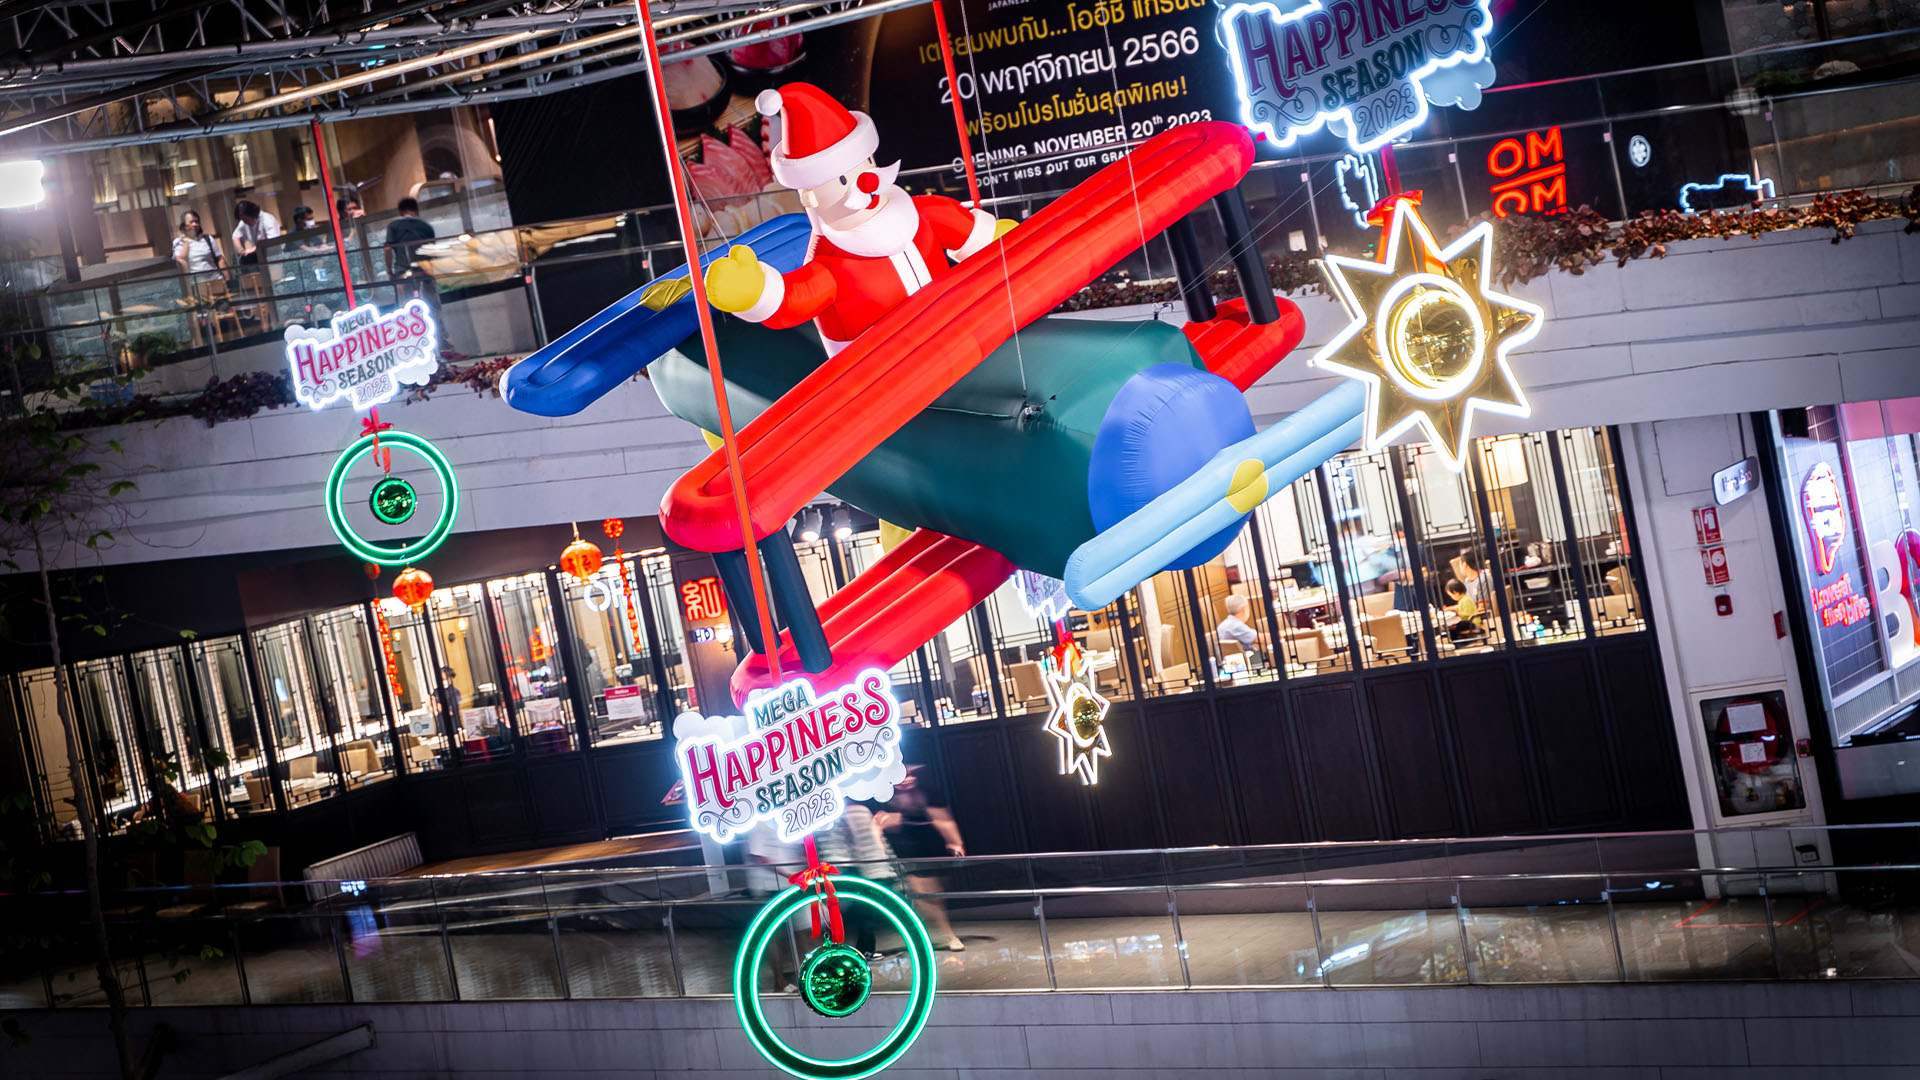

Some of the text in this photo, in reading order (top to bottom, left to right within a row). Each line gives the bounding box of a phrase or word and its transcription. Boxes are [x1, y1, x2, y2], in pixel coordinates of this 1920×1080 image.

[988, 0, 1029, 11] JAPANE
[980, 46, 1117, 96] พฤศจิกายน
[1123, 26, 1199, 67] 2566
[1235, 0, 1478, 99] HAPPINE
[1321, 28, 1427, 110] SEASON
[1355, 81, 1418, 144] 2023
[952, 144, 1029, 173] OENING
[1034, 125, 1127, 157] NOVEMBER
[1014, 166, 1042, 180] MISS
[1074, 155, 1097, 168] OUR
[1487, 125, 1565, 178] OM
[295, 305, 426, 384] HAPPINESS
[337, 310, 375, 334] MEGA
[338, 349, 396, 390] SEASON
[356, 374, 393, 403] 2023
[752, 685, 811, 730] MEGA
[687, 676, 890, 808] HAPPINESS
[755, 747, 844, 814] SEASON
[782, 788, 837, 838] 2023
